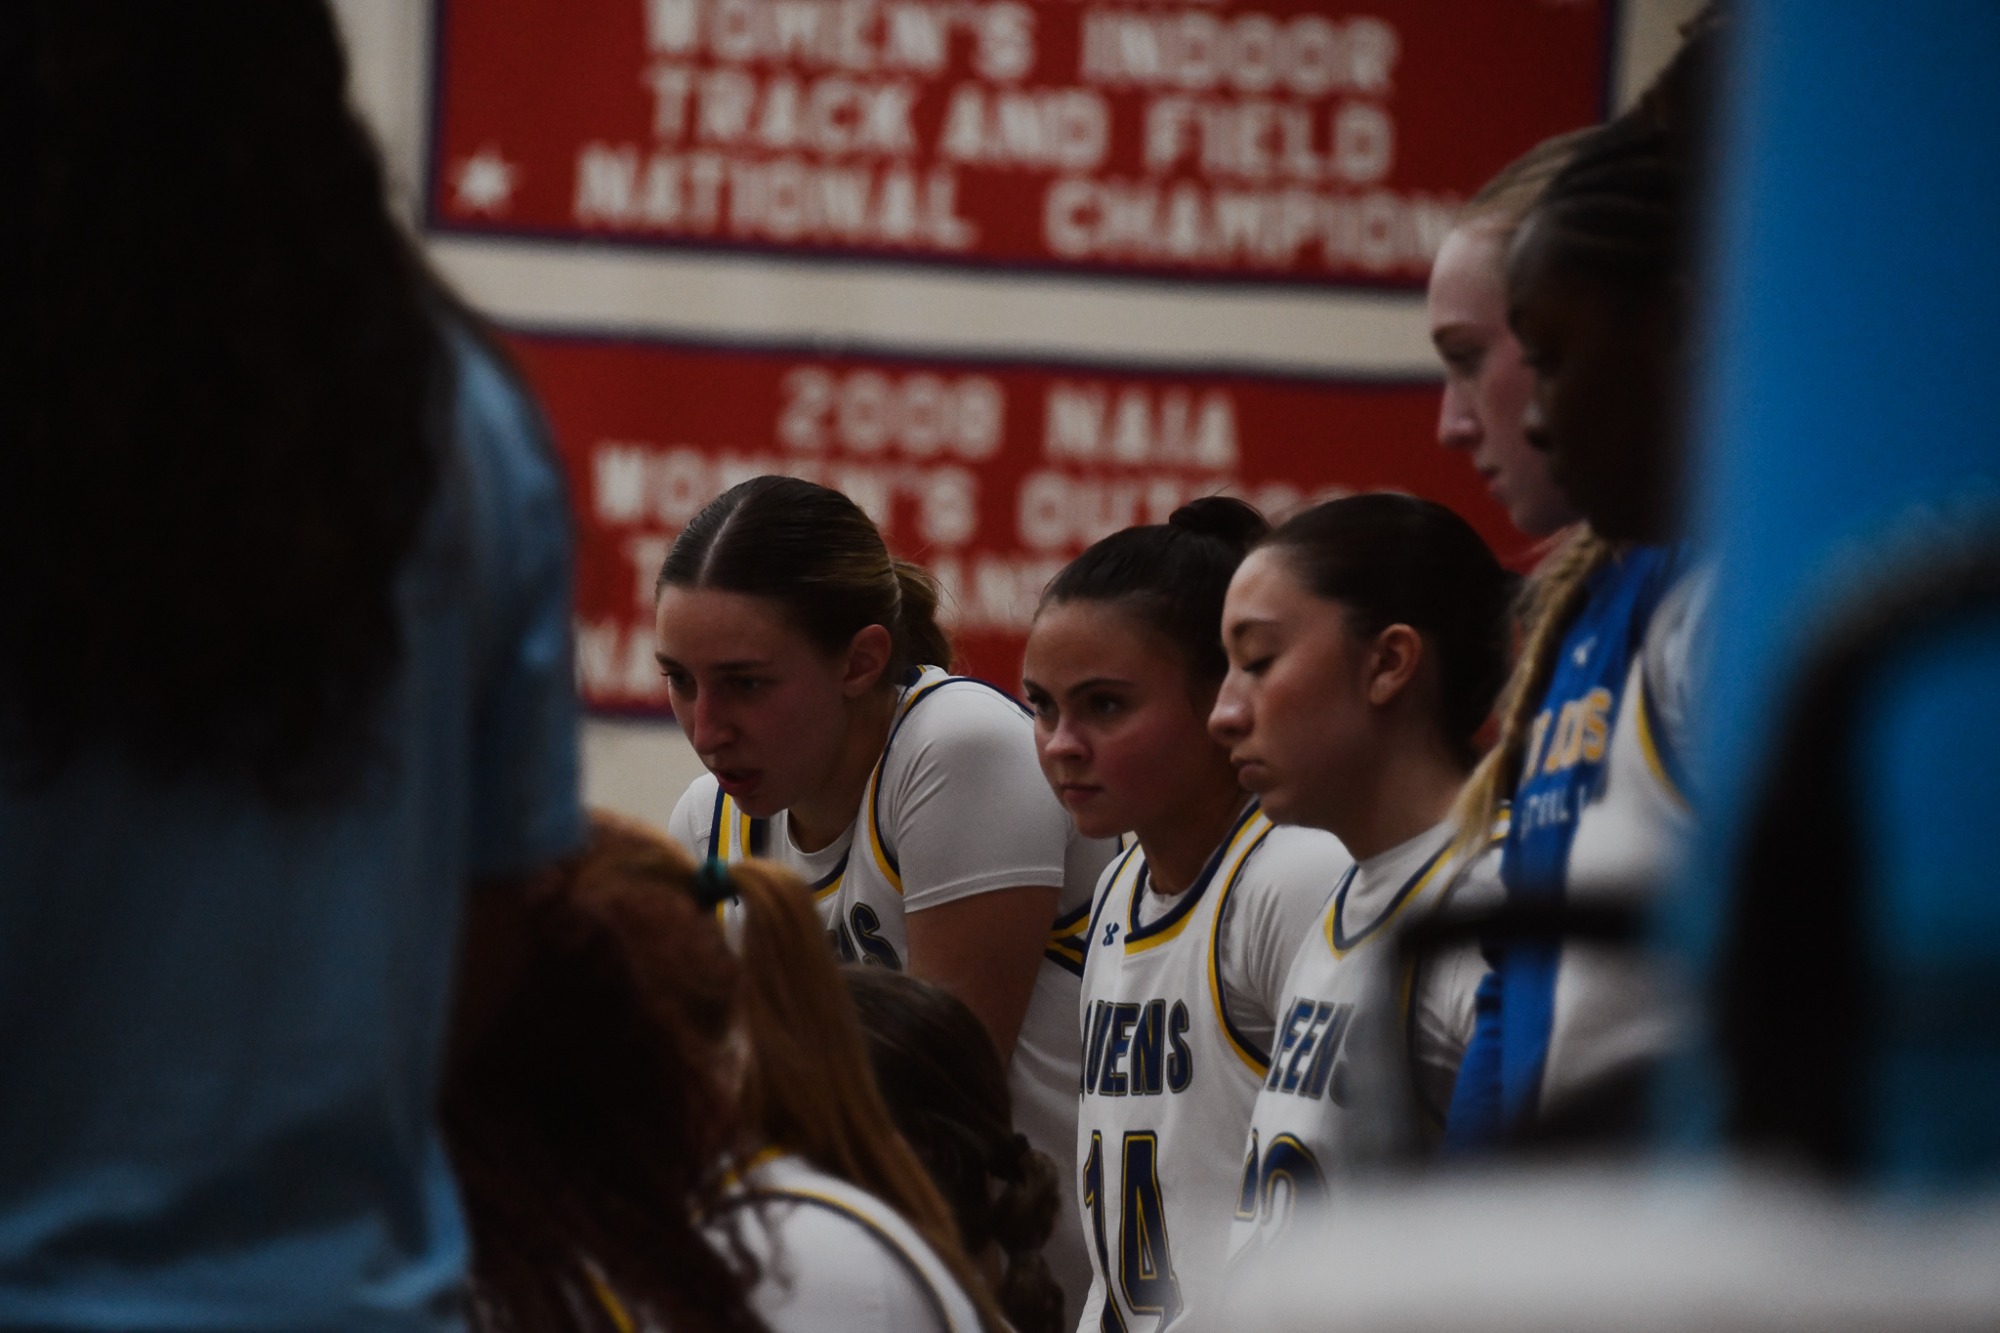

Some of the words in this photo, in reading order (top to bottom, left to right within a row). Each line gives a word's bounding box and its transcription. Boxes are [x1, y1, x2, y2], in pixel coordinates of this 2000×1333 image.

[645, 0, 1036, 80] WOMEN'S
[1081, 11, 1397, 94] INDOOR
[645, 66, 917, 154] TRACK
[943, 86, 1109, 168] AND
[1145, 95, 1393, 180] FIELD
[575, 144, 975, 248] NATIONAL
[1043, 387, 1239, 466] NAIA
[1083, 1130, 1184, 1333] 14
